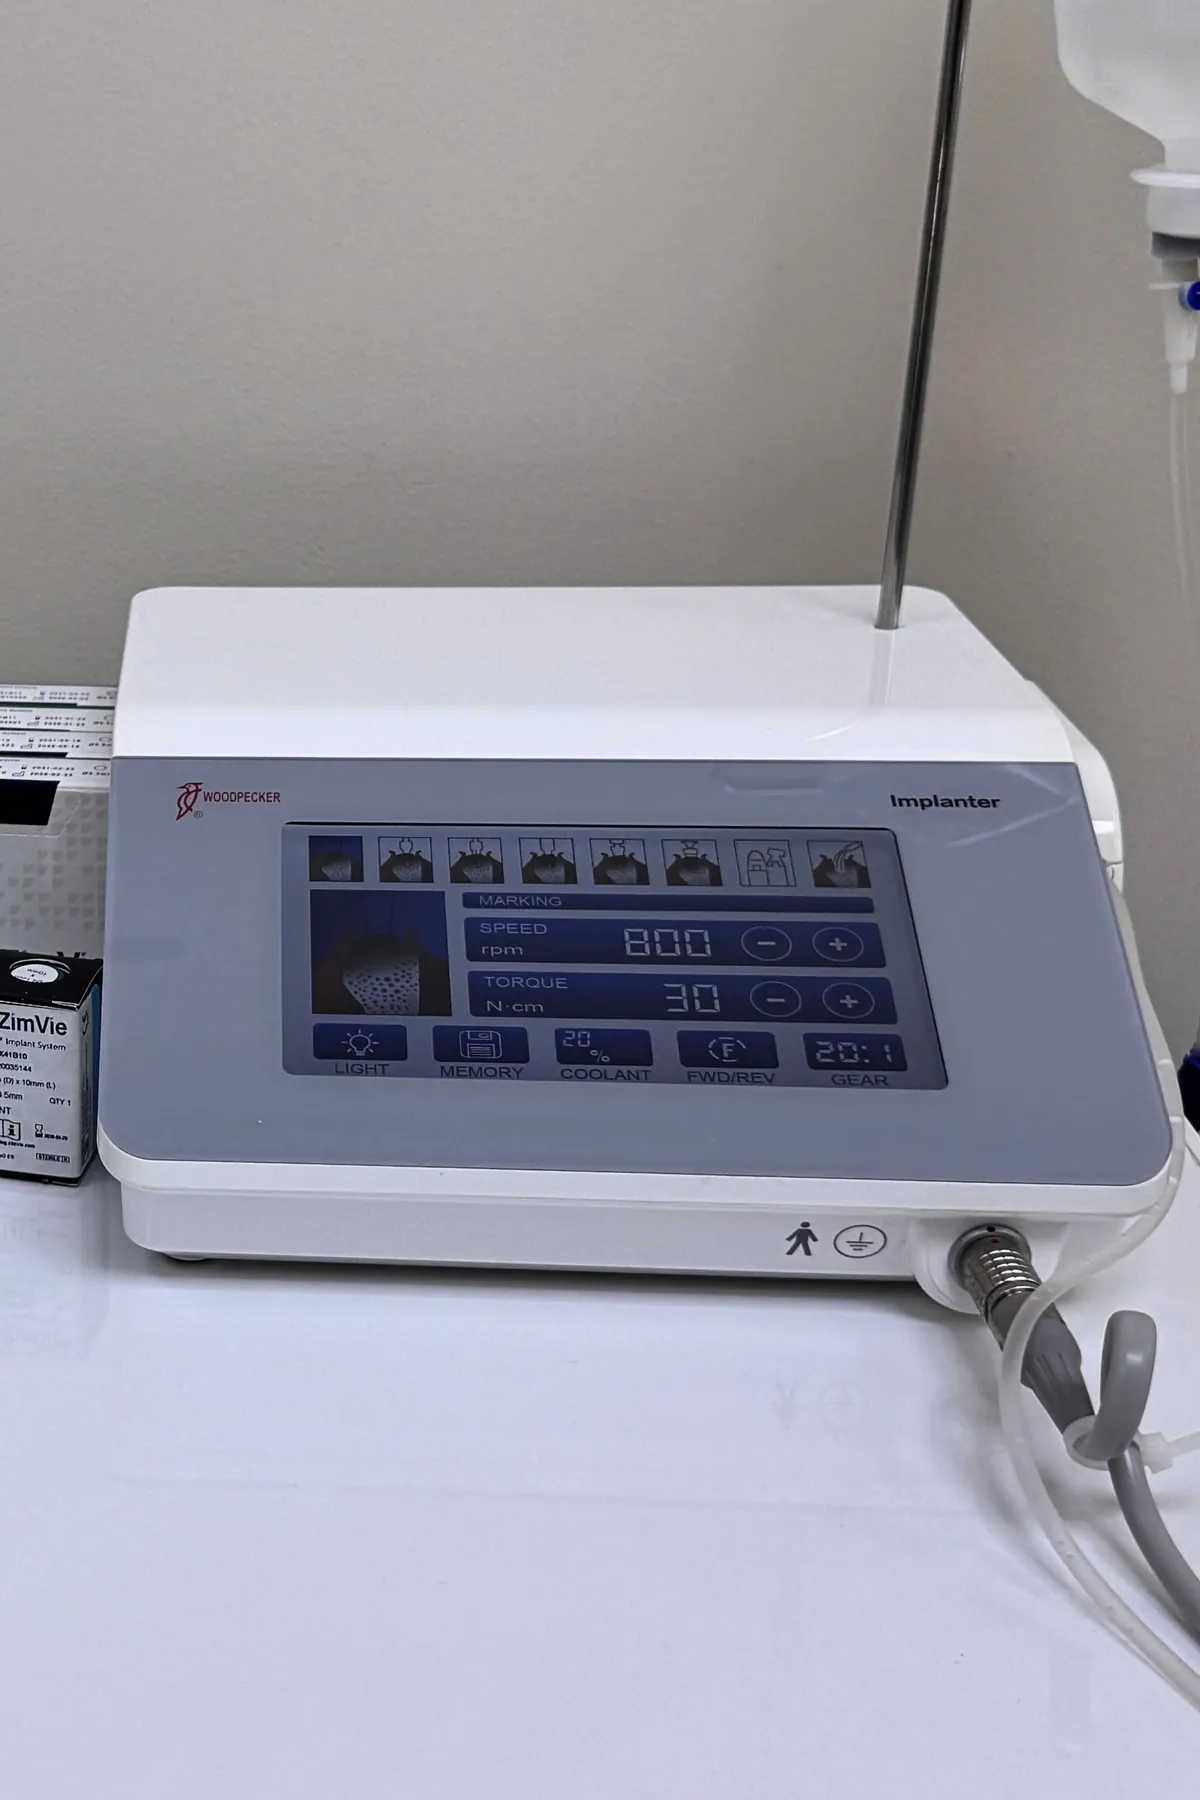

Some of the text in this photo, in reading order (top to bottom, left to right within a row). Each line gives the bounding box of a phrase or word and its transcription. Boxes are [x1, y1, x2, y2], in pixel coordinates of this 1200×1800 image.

[203, 791, 281, 803] WOODPECKER
[890, 794, 1001, 811] Implanter
[479, 895, 562, 907] MARKING
[479, 922, 548, 935] SPEED
[623, 928, 712, 957] 800
[481, 944, 524, 958] rpm
[484, 976, 568, 990] TORQUE
[662, 983, 721, 1013] 30
[5, 1038, 35, 1048] Implant
[38, 1041, 66, 1051] System
[563, 1030, 591, 1047] 20
[590, 1048, 610, 1064] %
[815, 1040, 893, 1064] 20:1
[334, 1063, 390, 1076] LIGHT
[440, 1065, 524, 1080] MEMORY
[560, 1068, 652, 1081] COOLANT
[22, 1079, 44, 1088] 10mm
[46, 1081, 56, 1090] (L)
[687, 1071, 776, 1084] FWD/REV
[830, 1073, 890, 1087] GEAR
[49, 1097, 65, 1106] QTY
